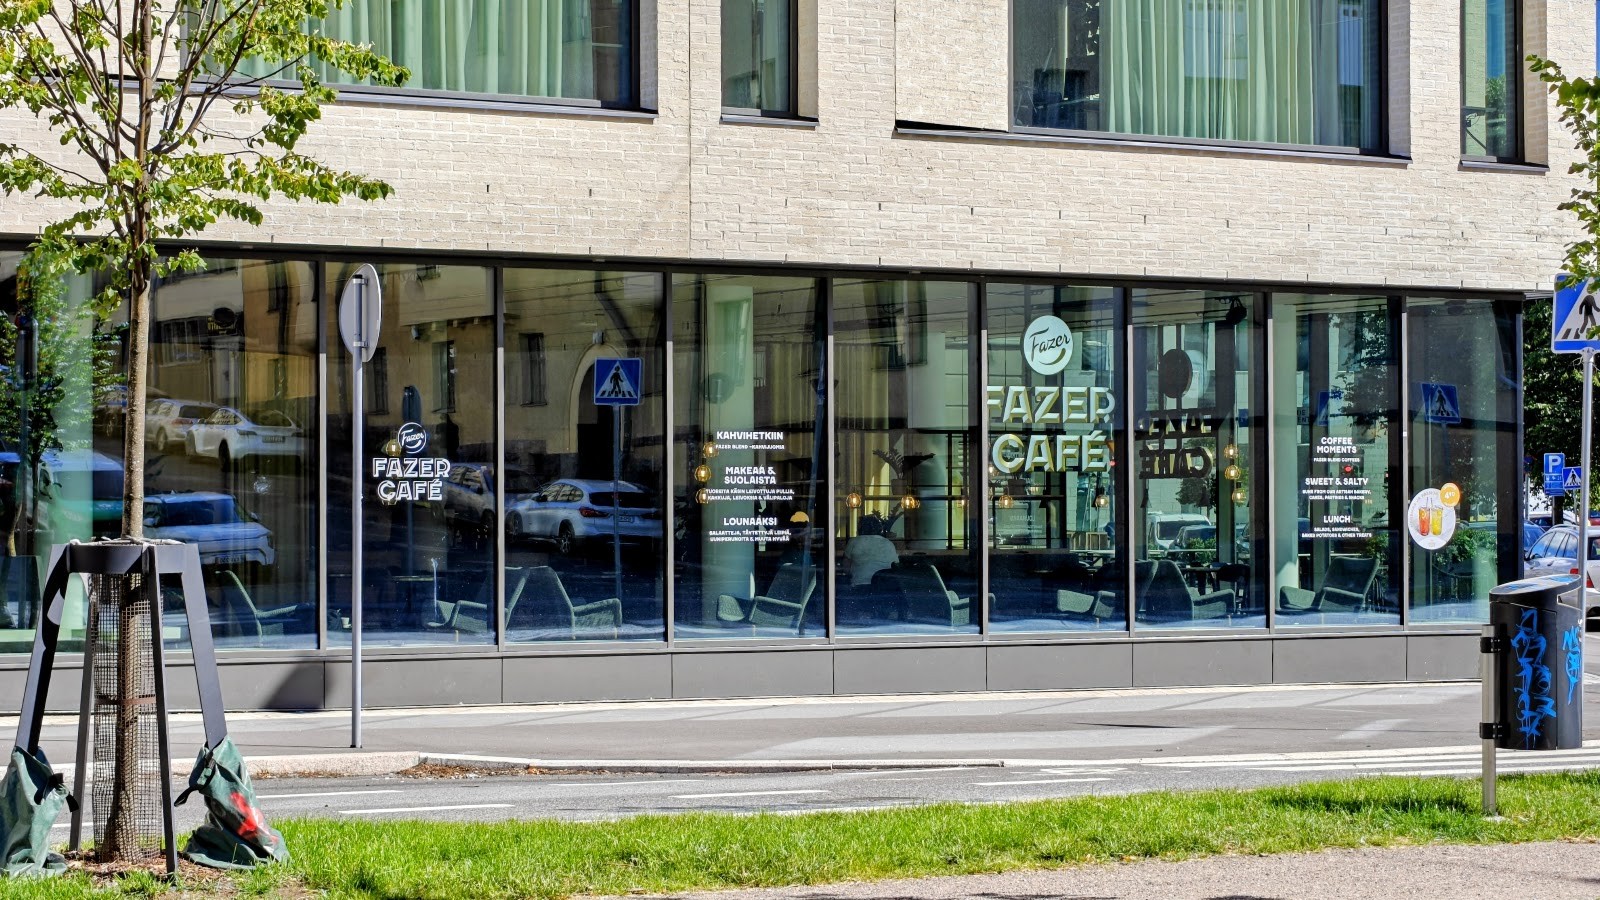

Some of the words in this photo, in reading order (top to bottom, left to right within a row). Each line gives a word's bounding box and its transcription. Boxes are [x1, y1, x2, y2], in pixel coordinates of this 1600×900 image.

[1030, 327, 1071, 361] Fazer
[986, 385, 1116, 424] FAZER
[401, 428, 425, 447] Fazer
[716, 431, 784, 440] KAHVIHETKIIN
[1320, 436, 1353, 445] COFFEE
[992, 430, 1108, 474] CAFÉ
[1316, 446, 1357, 454] MOMENTS
[372, 457, 451, 478] FAZER
[1548, 455, 1562, 473] P
[767, 466, 776, 475] &
[724, 476, 777, 485] SUOLAISTA
[1305, 477, 1334, 486] SWEET
[1335, 477, 1342, 486] &
[1343, 477, 1369, 486] SALTY
[377, 478, 443, 501] CAFÉ
[723, 517, 777, 526] LOUNAAKSI
[1323, 515, 1351, 524] LUNCH
